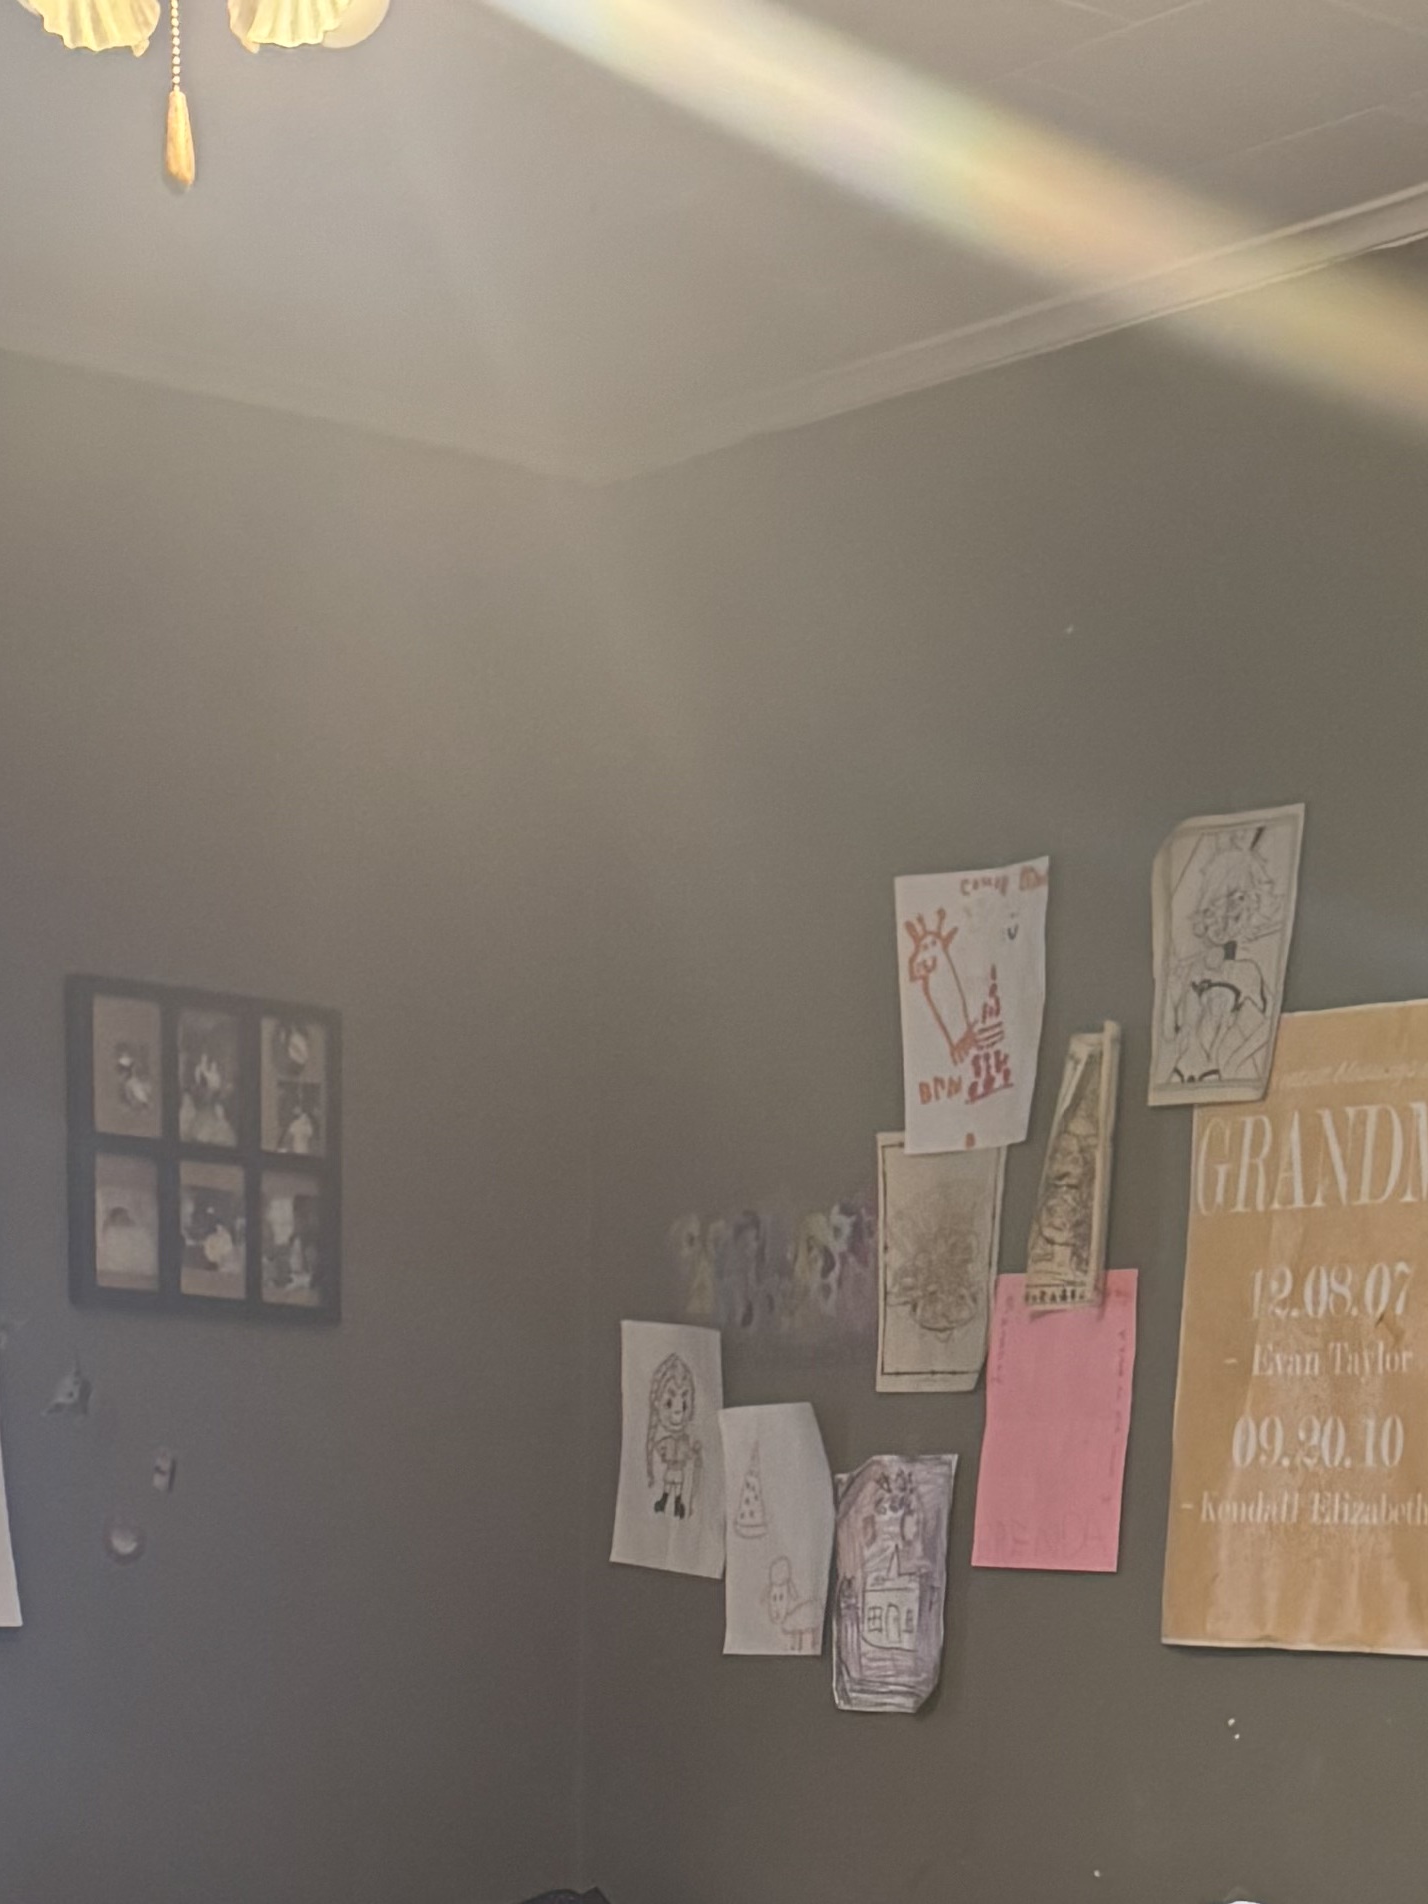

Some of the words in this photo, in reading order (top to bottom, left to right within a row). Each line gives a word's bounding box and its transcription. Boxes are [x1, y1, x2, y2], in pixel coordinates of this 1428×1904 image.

[1252, 1261, 1415, 1320] 12.08.07
[1252, 1343, 1320, 1377] Evan
[1329, 1340, 1414, 1383] Taylor
[1232, 1415, 1405, 1469] 09.20.10
[1200, 1490, 1301, 1524] Kendall
